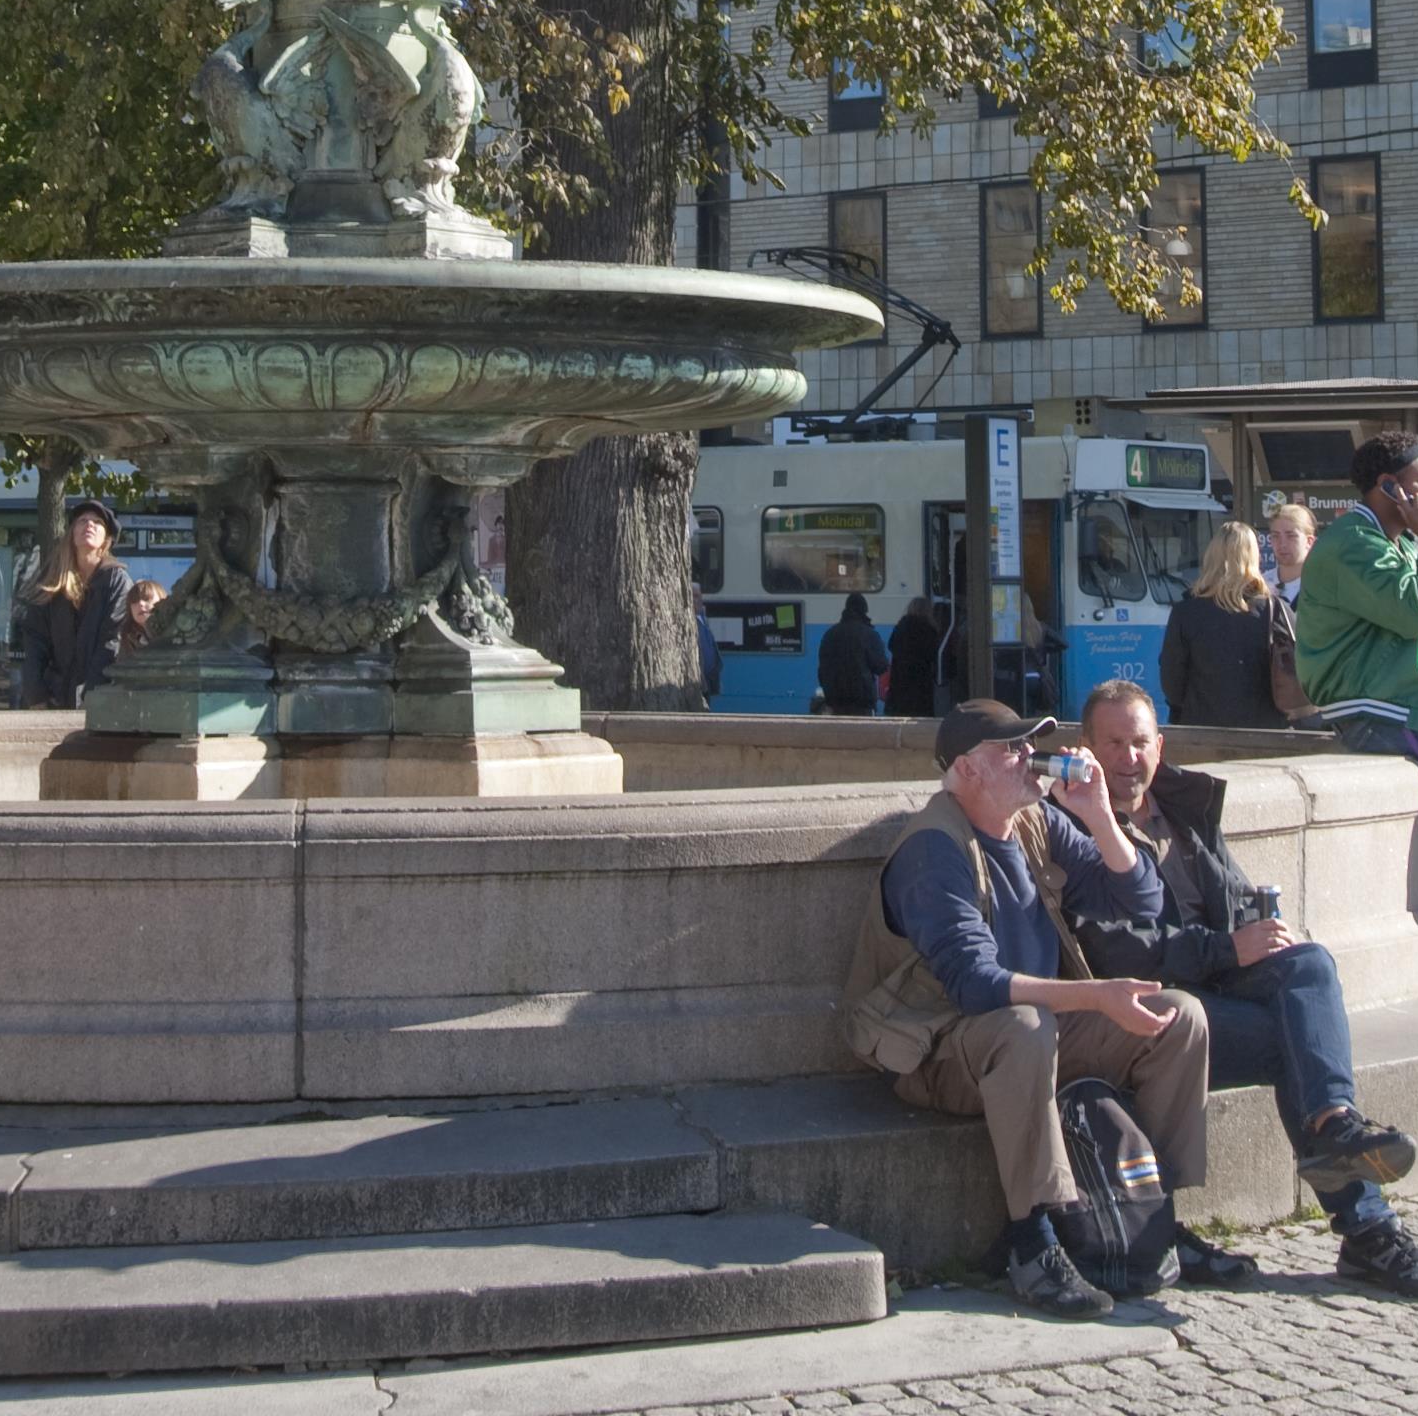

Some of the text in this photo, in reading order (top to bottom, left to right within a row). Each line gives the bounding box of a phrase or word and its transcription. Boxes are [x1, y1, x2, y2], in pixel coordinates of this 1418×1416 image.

[996, 428, 1009, 466] E
[1131, 449, 1143, 483] 4
[785, 512, 795, 532] 4
[1112, 662, 1145, 680] 302
